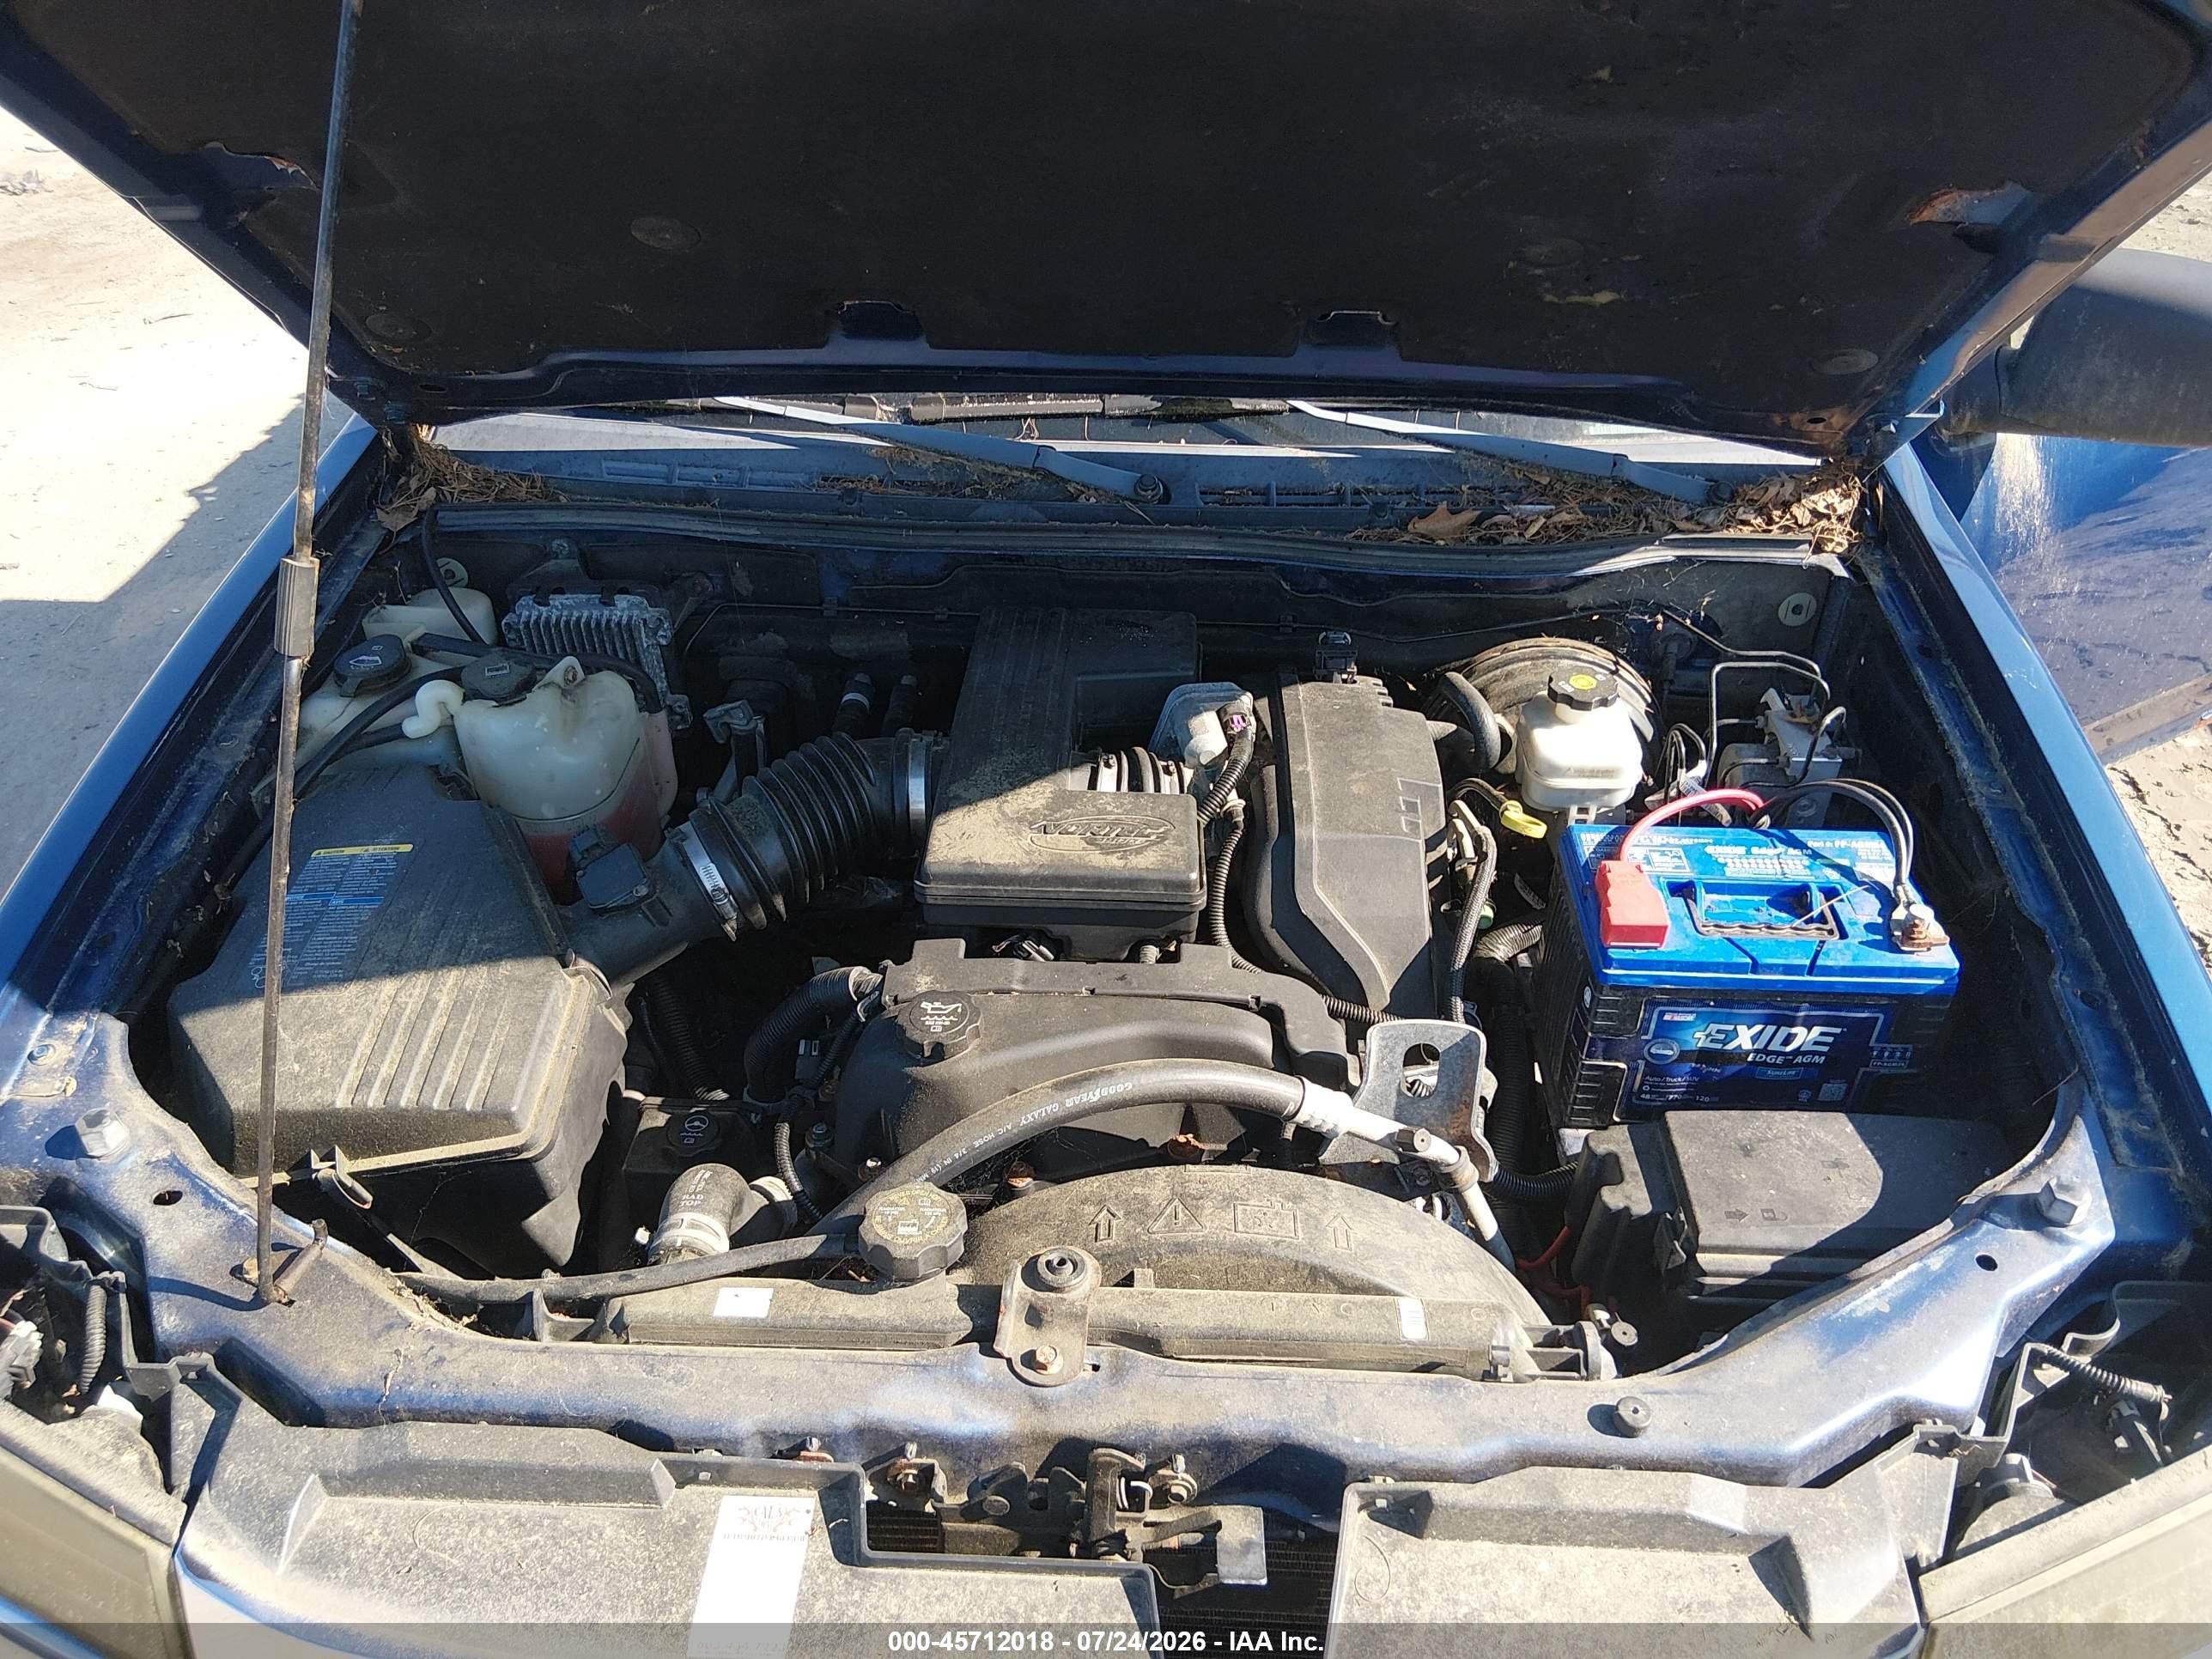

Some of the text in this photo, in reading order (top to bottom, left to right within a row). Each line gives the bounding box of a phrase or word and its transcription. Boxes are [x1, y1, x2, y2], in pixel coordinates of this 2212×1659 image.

[1693, 1023, 1842, 1053] EXIDE
[1793, 1054, 1826, 1065] AGM
[1066, 1082, 1133, 1109] GOODYEAR
[1019, 1103, 1060, 1127] GALAXY
[997, 1121, 1012, 1136] A/C
[973, 1132, 996, 1149] HOSE
[955, 1146, 968, 1158] 3/4
[943, 1158, 953, 1166] IN
